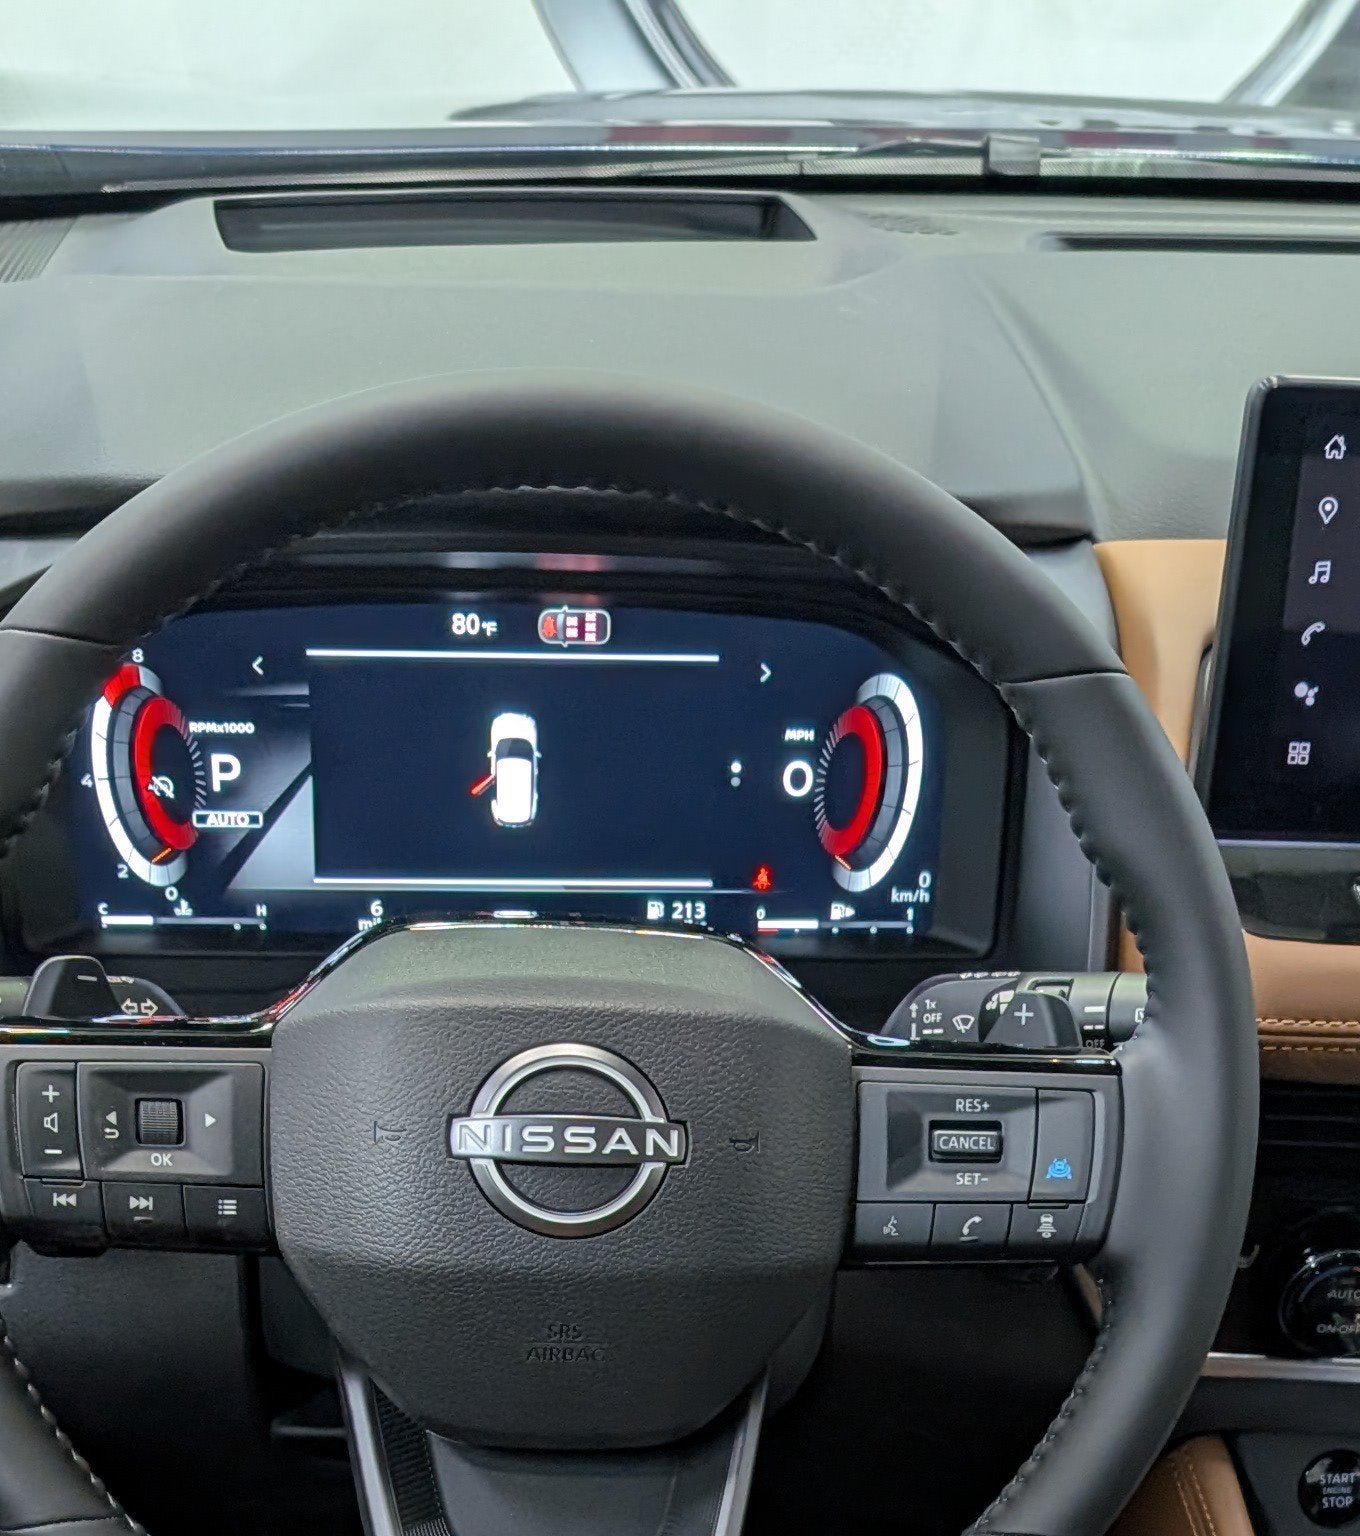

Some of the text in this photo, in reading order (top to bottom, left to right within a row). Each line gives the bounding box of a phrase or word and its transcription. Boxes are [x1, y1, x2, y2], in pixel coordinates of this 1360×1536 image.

[131, 647, 144, 663] 8
[188, 721, 256, 734] RPMx1000
[783, 728, 816, 742] MPH
[210, 752, 241, 793] P
[782, 759, 815, 798] 0
[80, 773, 93, 789] 4
[206, 812, 250, 827] AUTO
[116, 863, 129, 879] 2
[917, 870, 932, 889] 0
[164, 885, 179, 901] 0
[890, 887, 931, 903] km/h
[97, 902, 109, 916] C
[255, 903, 268, 917] H
[370, 898, 384, 917] 6
[671, 900, 707, 920] 213
[756, 907, 766, 920] 0
[905, 906, 915, 921] 1
[925, 999, 937, 1010] 1x
[922, 1012, 943, 1024] OFF
[955, 1098, 991, 1113] RES+
[457, 1123, 680, 1158] NISSAN
[939, 1135, 997, 1151] CANCEL
[150, 1152, 173, 1168] OK
[546, 1323, 583, 1339] SRS
[1319, 1472, 1356, 1486] START
[1321, 1495, 1354, 1509] STOP
